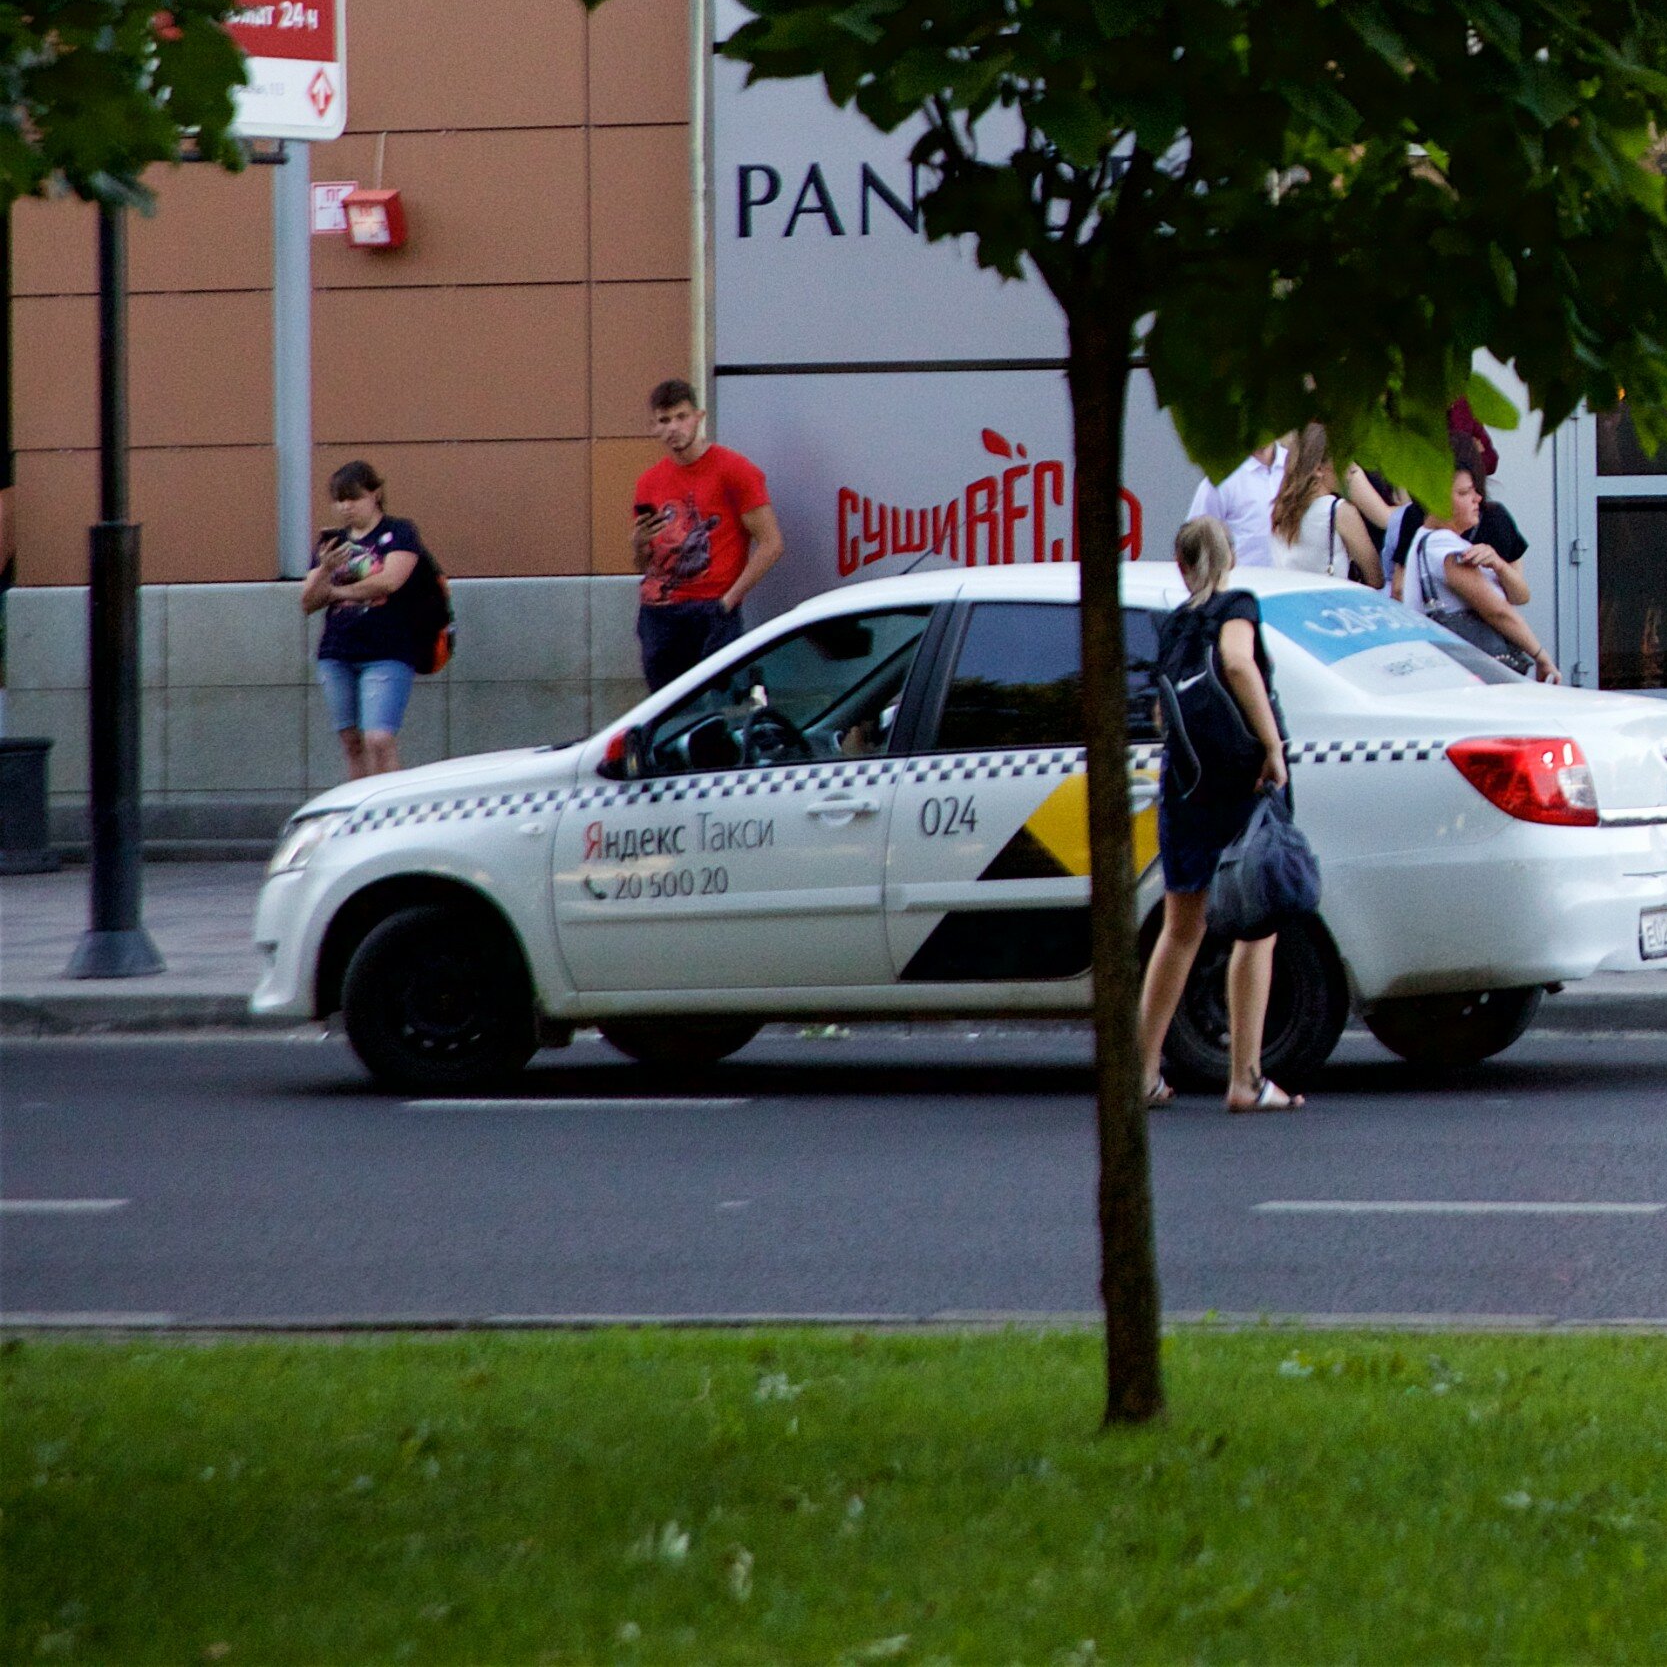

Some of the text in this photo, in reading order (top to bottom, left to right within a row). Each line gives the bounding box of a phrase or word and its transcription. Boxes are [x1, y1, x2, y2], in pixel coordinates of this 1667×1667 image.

[279, 0, 304, 28] 24
[921, 794, 979, 837] 024
[582, 811, 775, 863] Яндекс Такси
[614, 866, 730, 901] 20 500 20
